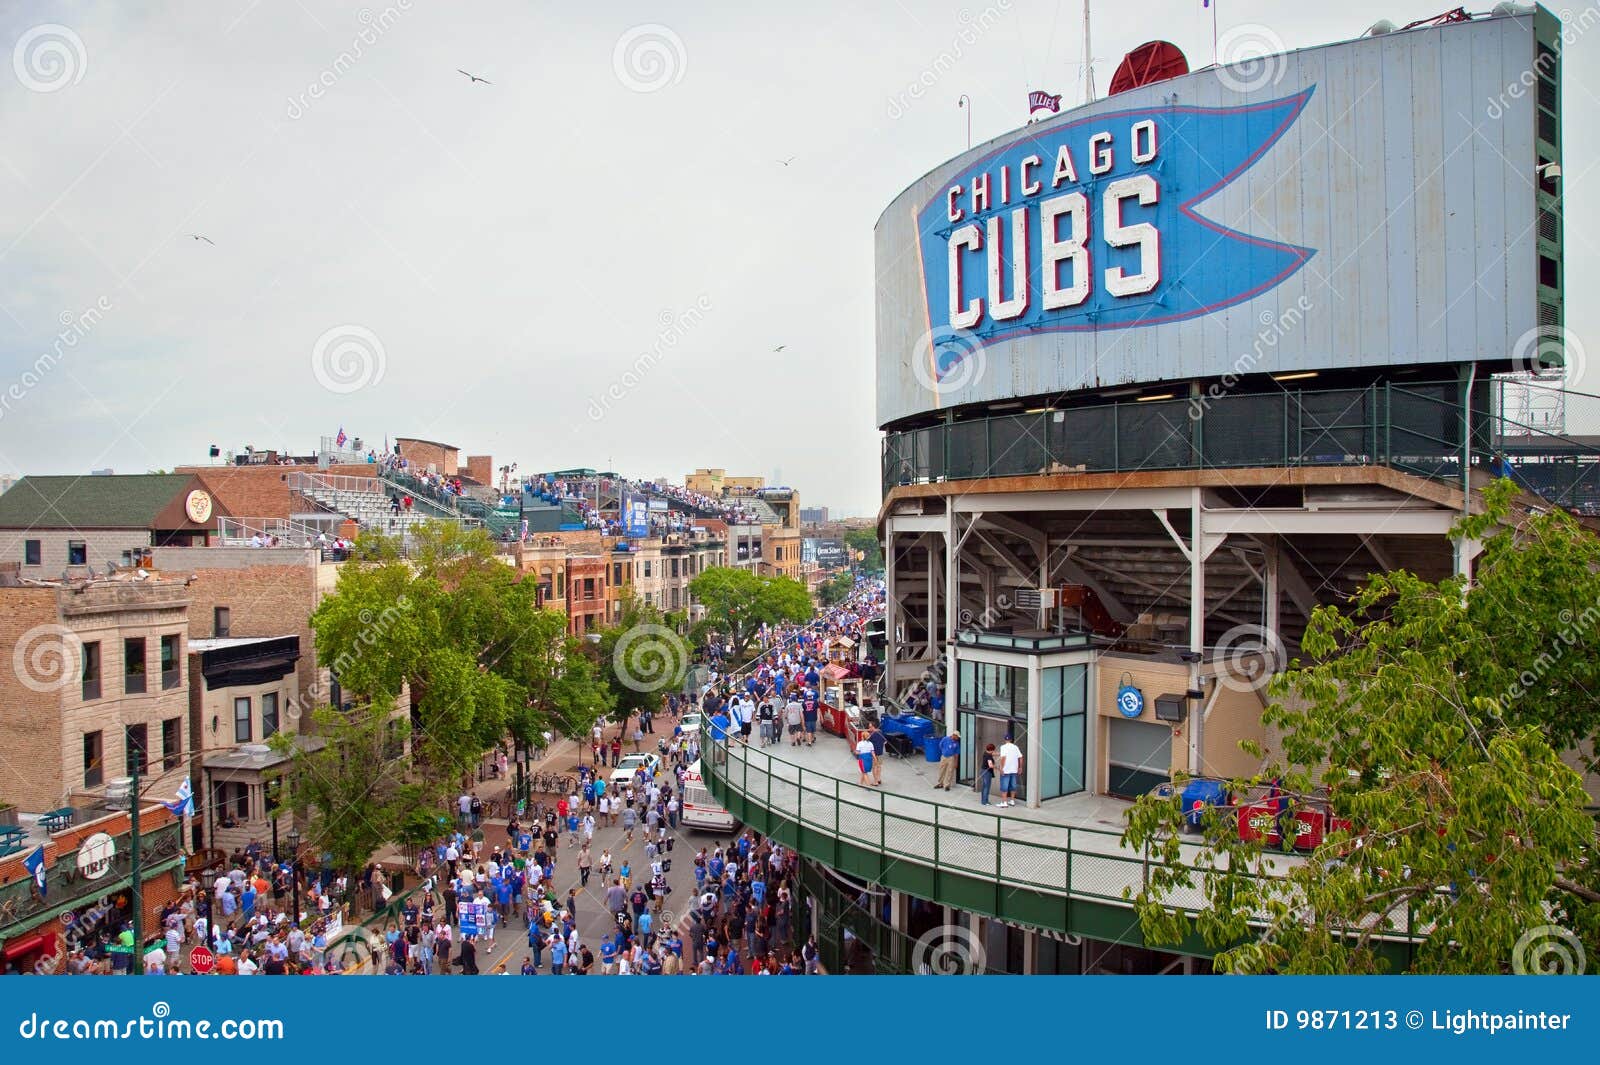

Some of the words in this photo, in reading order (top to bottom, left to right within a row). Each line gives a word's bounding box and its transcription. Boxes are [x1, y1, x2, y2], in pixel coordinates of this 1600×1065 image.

[947, 119, 1157, 222] CHICAGO
[948, 173, 1161, 330] CUBS
[192, 954, 212, 965] STOP
